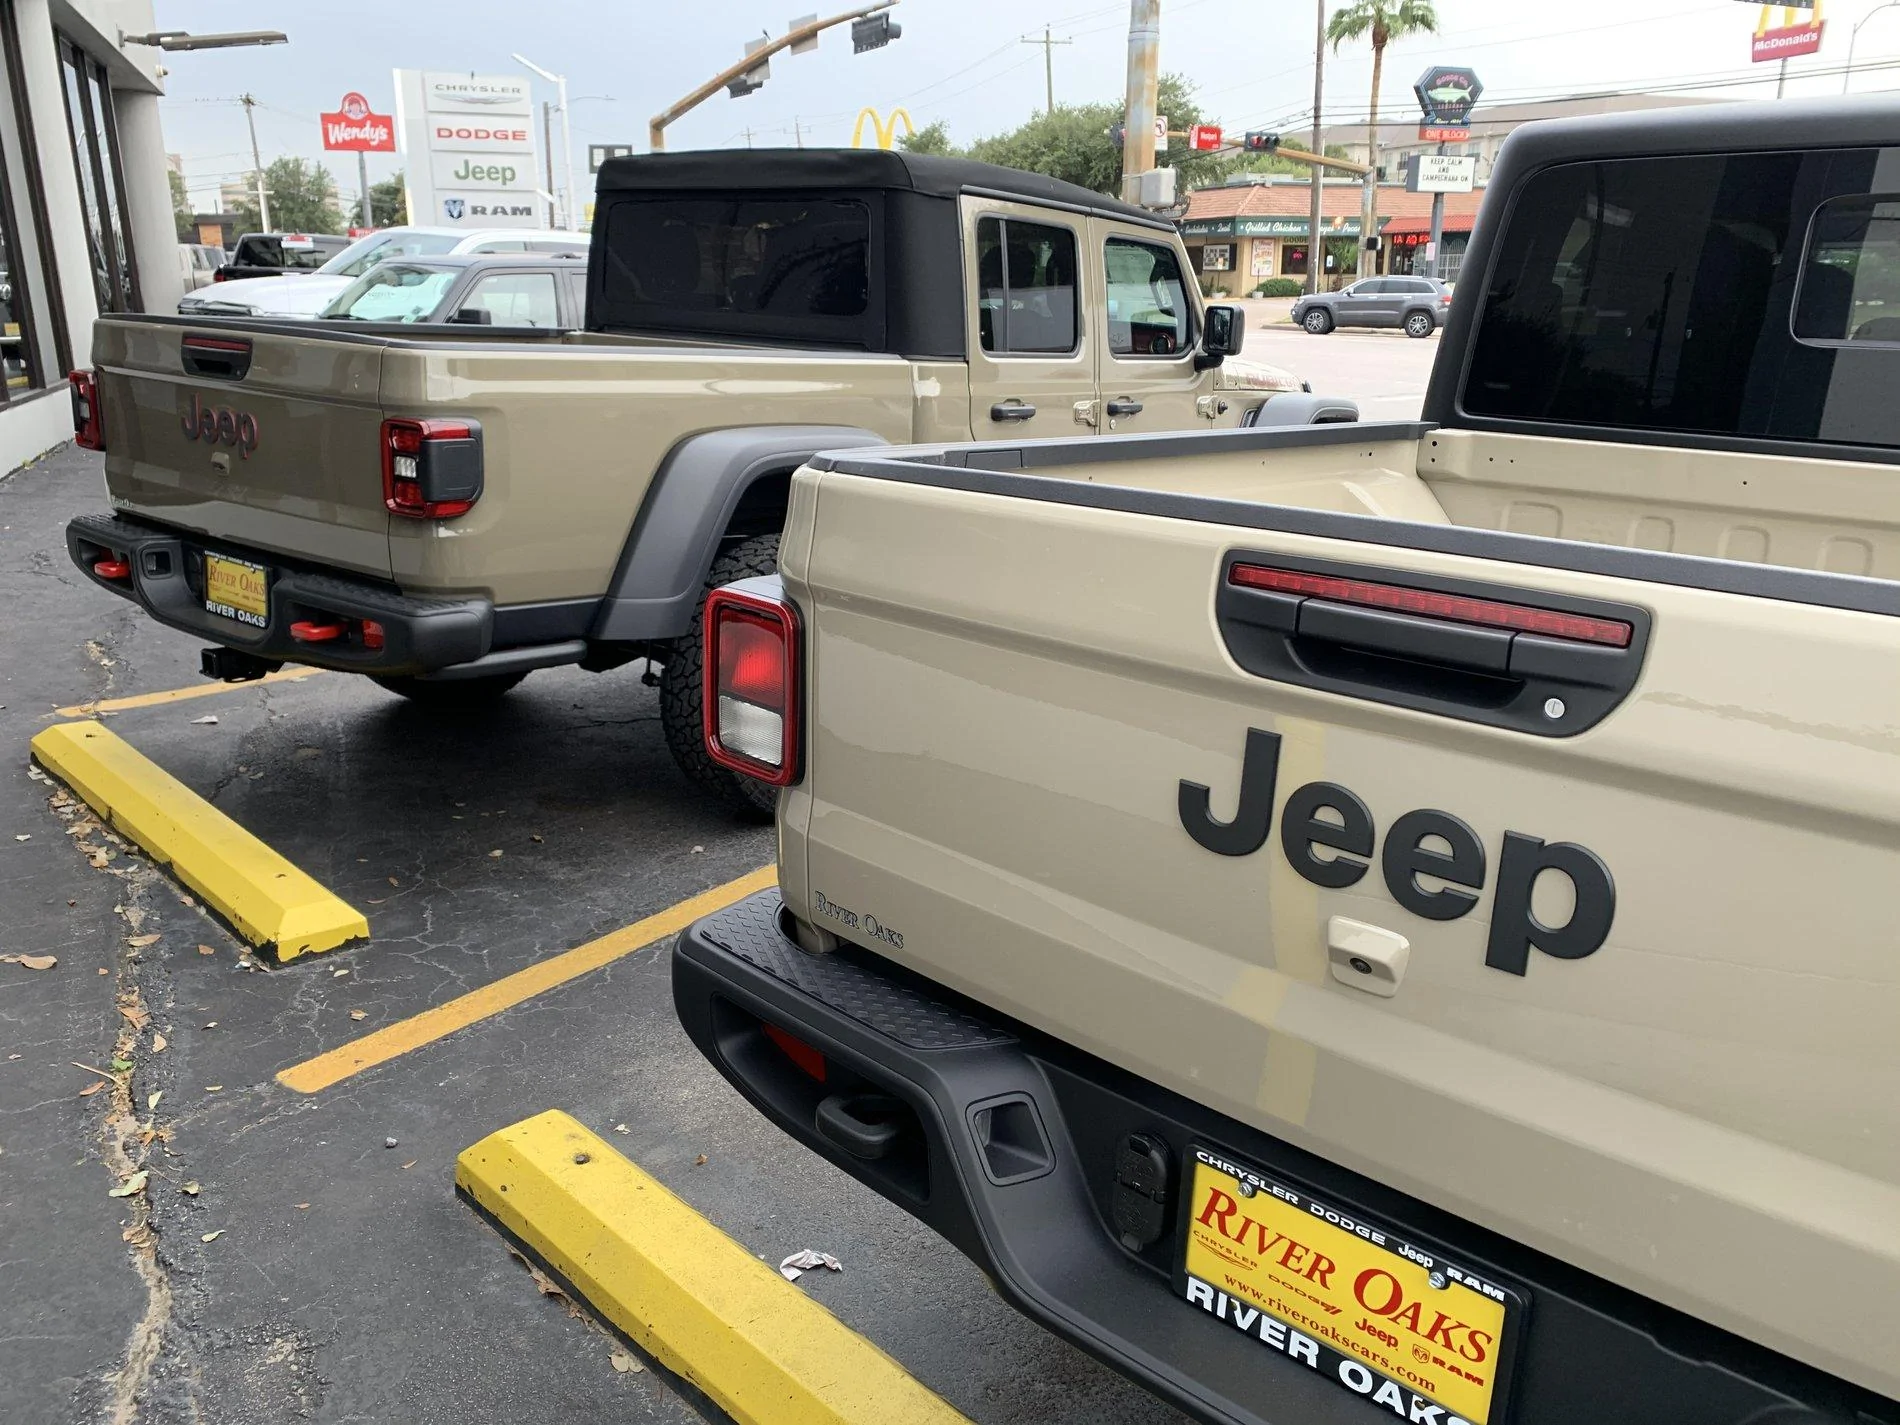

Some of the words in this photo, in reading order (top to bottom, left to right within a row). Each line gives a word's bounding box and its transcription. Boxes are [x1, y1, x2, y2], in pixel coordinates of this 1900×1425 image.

[1754, 32, 1818, 51] McDonald's
[434, 83, 522, 94] CHRYSLER
[327, 120, 389, 146] Wendy's
[436, 127, 527, 141] DODGE
[1426, 130, 1441, 139] ONE
[454, 159, 516, 186] Jeep
[1430, 157, 1445, 165] KEEP
[1447, 158, 1463, 166] CALM
[1438, 165, 1450, 174] AND
[470, 204, 533, 217] RAM
[1245, 221, 1270, 235] Grilled
[1272, 221, 1302, 233] Chicken
[181, 391, 259, 461] Jeep
[209, 563, 237, 588] RIVER
[239, 573, 266, 597] OAKS
[206, 599, 236, 619] RIVER
[237, 610, 267, 629] OAKS
[1178, 727, 1617, 978] Jeep
[815, 890, 860, 930] RIVER
[864, 914, 905, 950] OAKS
[1196, 1151, 1300, 1205] CHRYSLER
[1310, 1203, 1386, 1247] DODGE
[1398, 1244, 1434, 1269] Jeep
[1446, 1266, 1506, 1302] RAM
[1195, 1186, 1337, 1291] RIVER
[1353, 1268, 1493, 1364] OAKS
[1186, 1275, 1320, 1369] RIVER
[1193, 1229, 1259, 1269] CHRYSLER
[1268, 1273, 1342, 1316] DODGE
[1354, 1317, 1400, 1351] Jeep
[1431, 1356, 1485, 1388] RAM
[1224, 1273, 1437, 1394] www.riveroakscars.com
